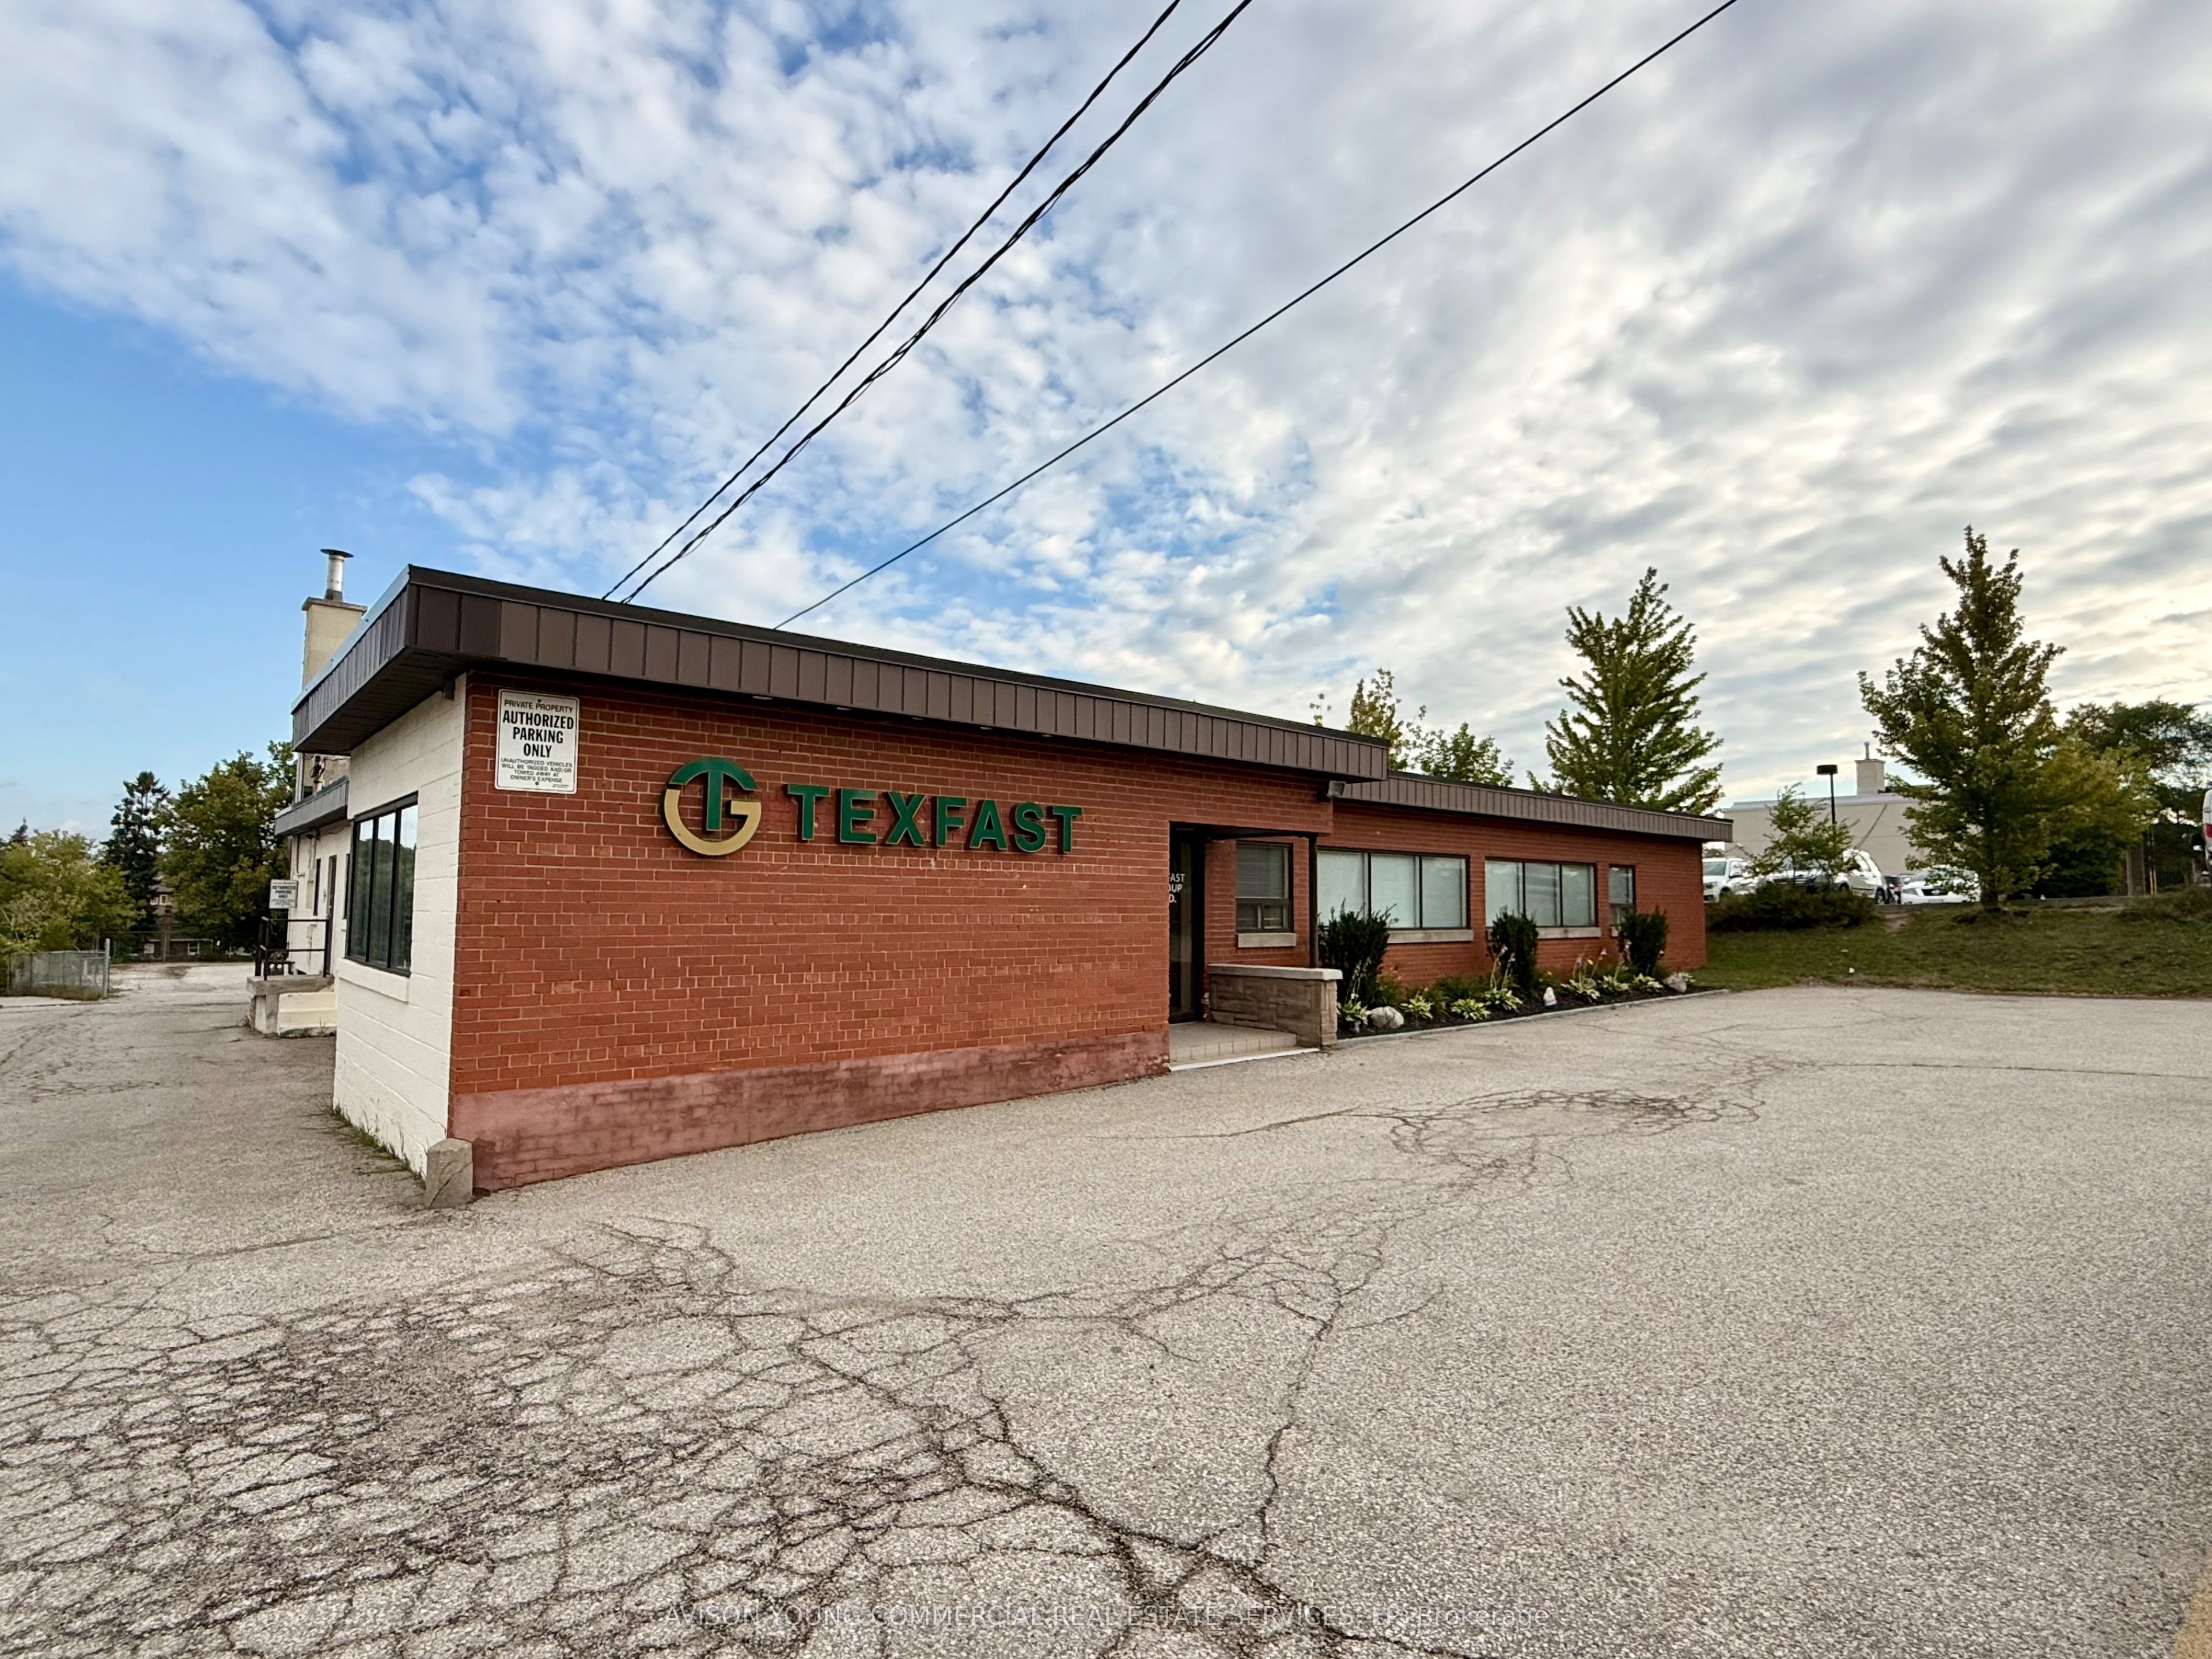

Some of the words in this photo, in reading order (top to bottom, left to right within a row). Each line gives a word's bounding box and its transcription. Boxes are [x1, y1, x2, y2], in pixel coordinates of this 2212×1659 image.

[504, 699, 533, 709] PRIVATE
[536, 703, 574, 713] PROPERTY
[502, 710, 574, 729] AUTHORIZED
[513, 727, 563, 744] PARKING
[524, 743, 552, 757] ONLY
[501, 757, 545, 766] UNAUTHORIZED
[785, 783, 1082, 853] TEXFAST
[1169, 873, 1185, 882] AST
